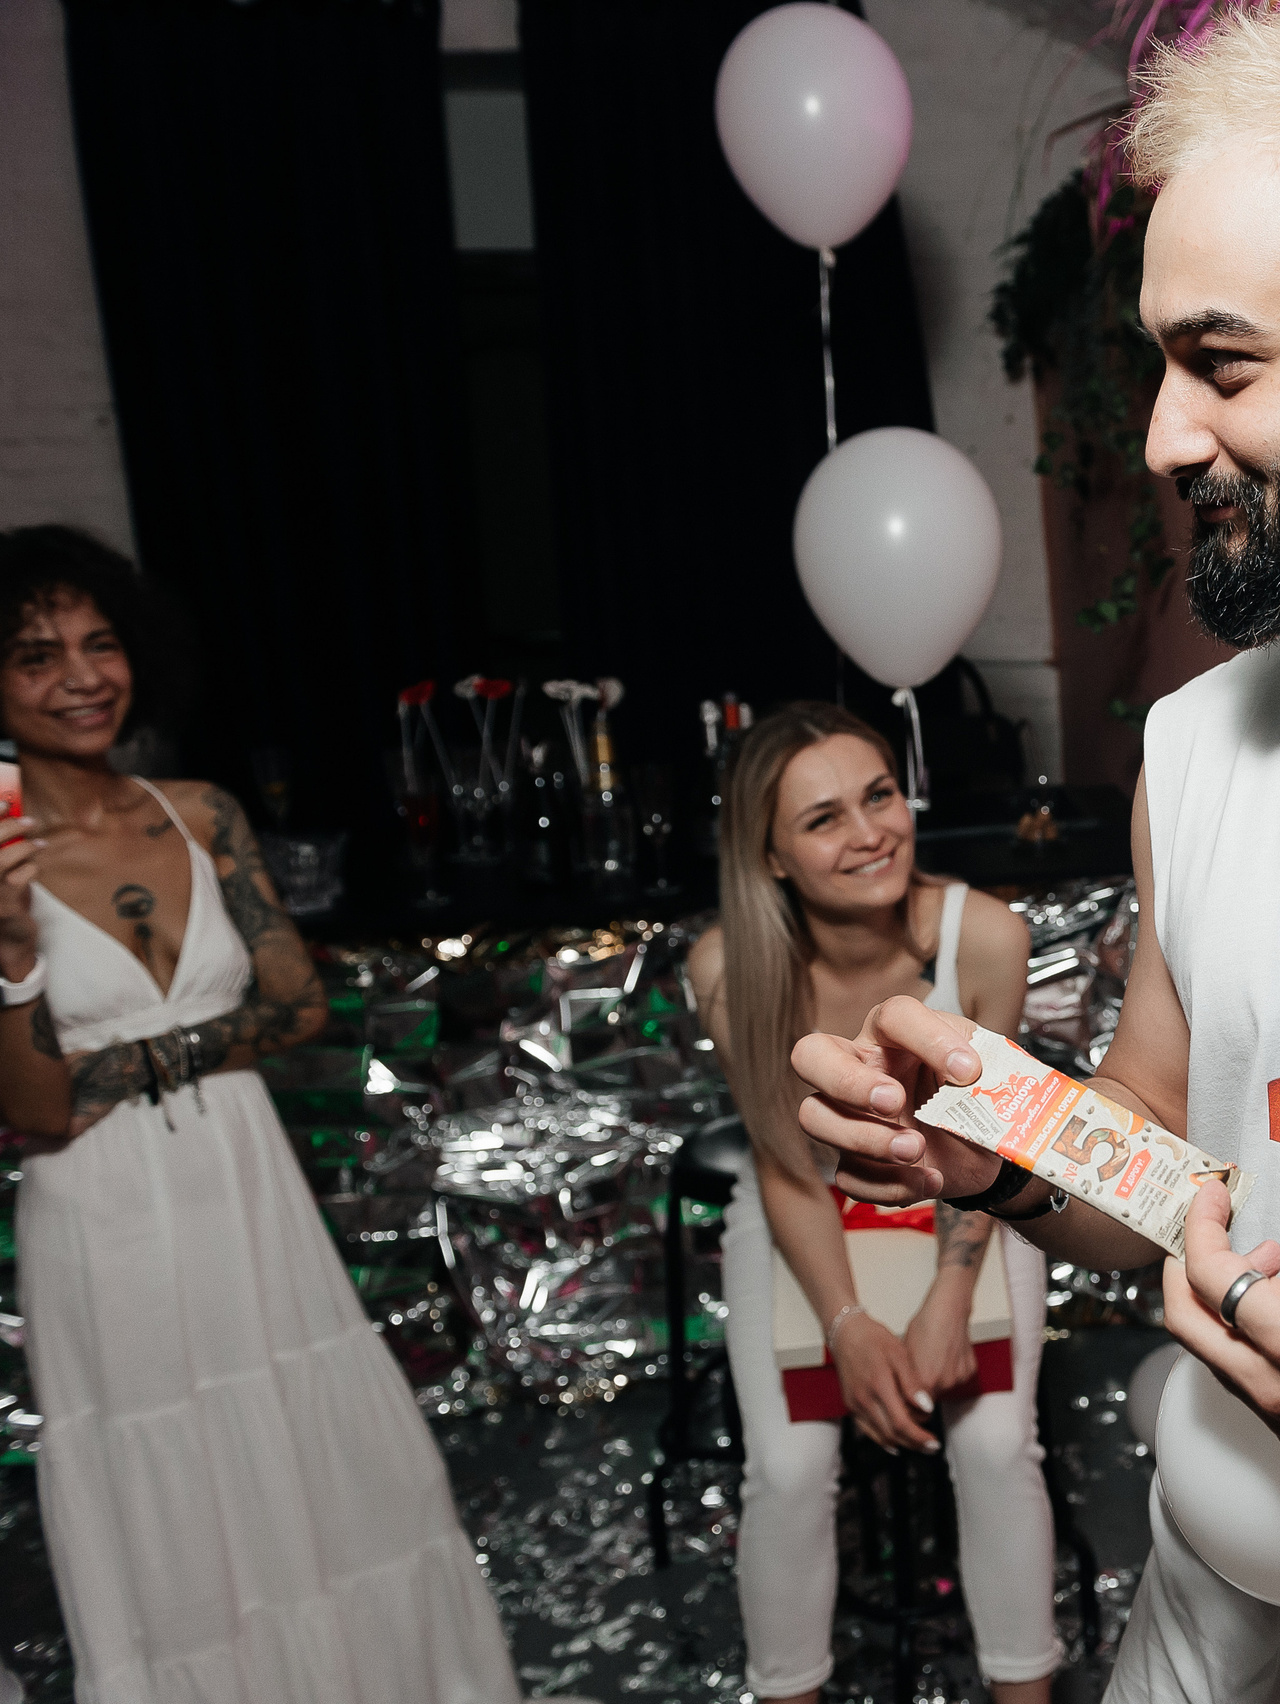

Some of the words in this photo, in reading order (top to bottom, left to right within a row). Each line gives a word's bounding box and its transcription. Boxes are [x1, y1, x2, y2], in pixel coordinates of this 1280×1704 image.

[997, 1074, 1037, 1121] bionova
[1053, 1110, 1062, 1118] &
[1057, 1086, 1079, 1112] ОРЕХИ
[1025, 1116, 1058, 1158] АПЕЛЬСИН
[1050, 1113, 1130, 1181] 5
[1120, 1185, 1129, 1193] В
[1125, 1157, 1145, 1187] ДОРОГУ!
